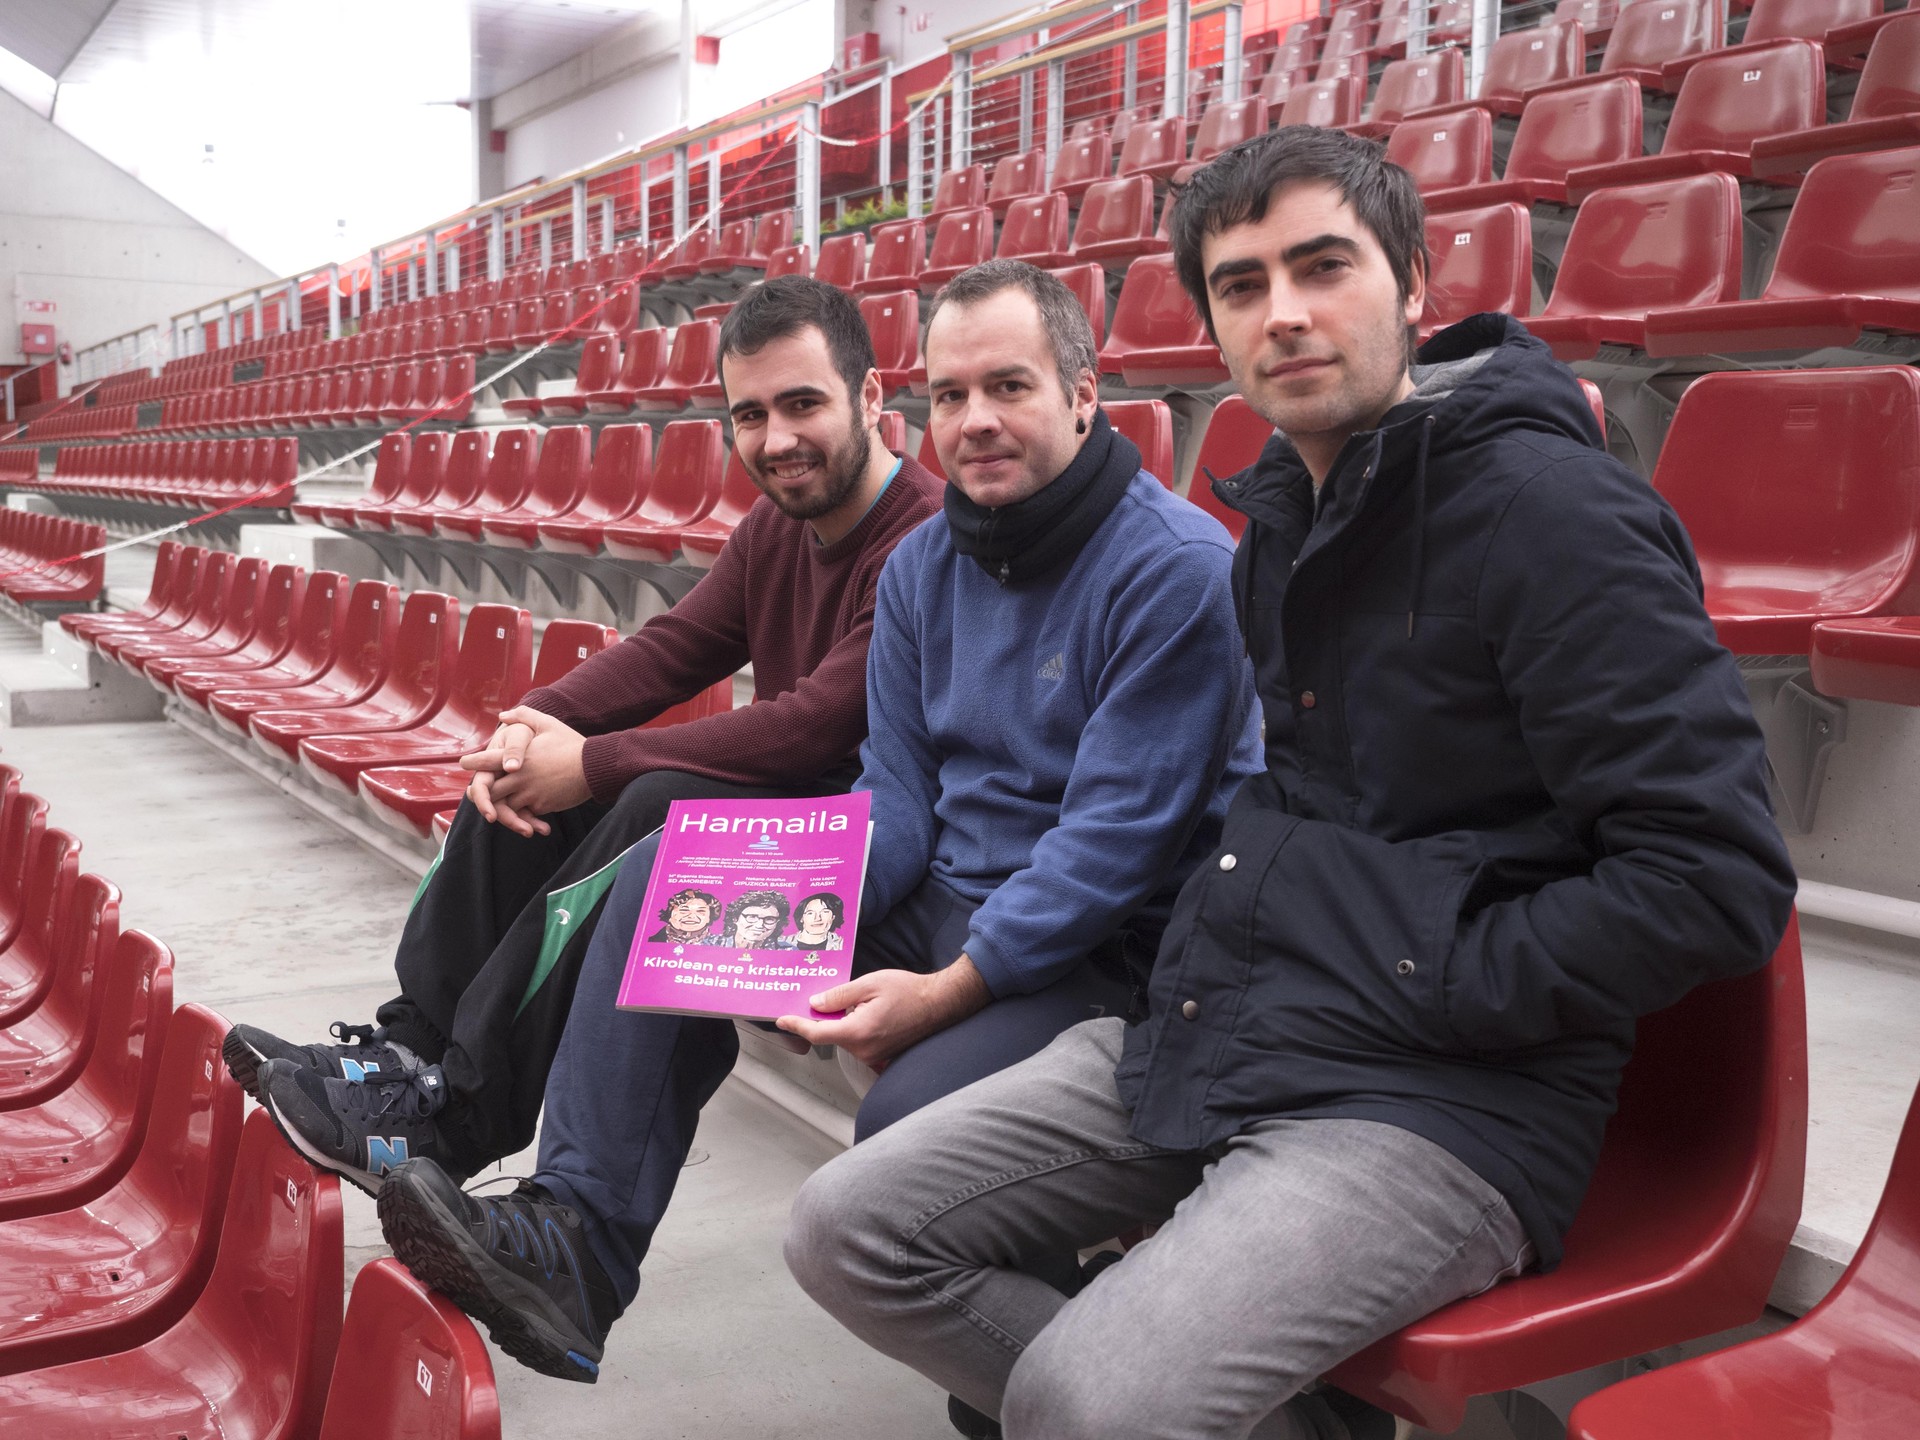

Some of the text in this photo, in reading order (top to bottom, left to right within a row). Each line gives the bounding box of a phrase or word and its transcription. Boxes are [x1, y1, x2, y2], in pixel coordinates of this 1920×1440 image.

[679, 810, 848, 834] Harmaila
[643, 957, 838, 977] Kirolean ere kristalezko
[674, 973, 801, 992] sabaia hausten
[366, 1136, 409, 1175] N
